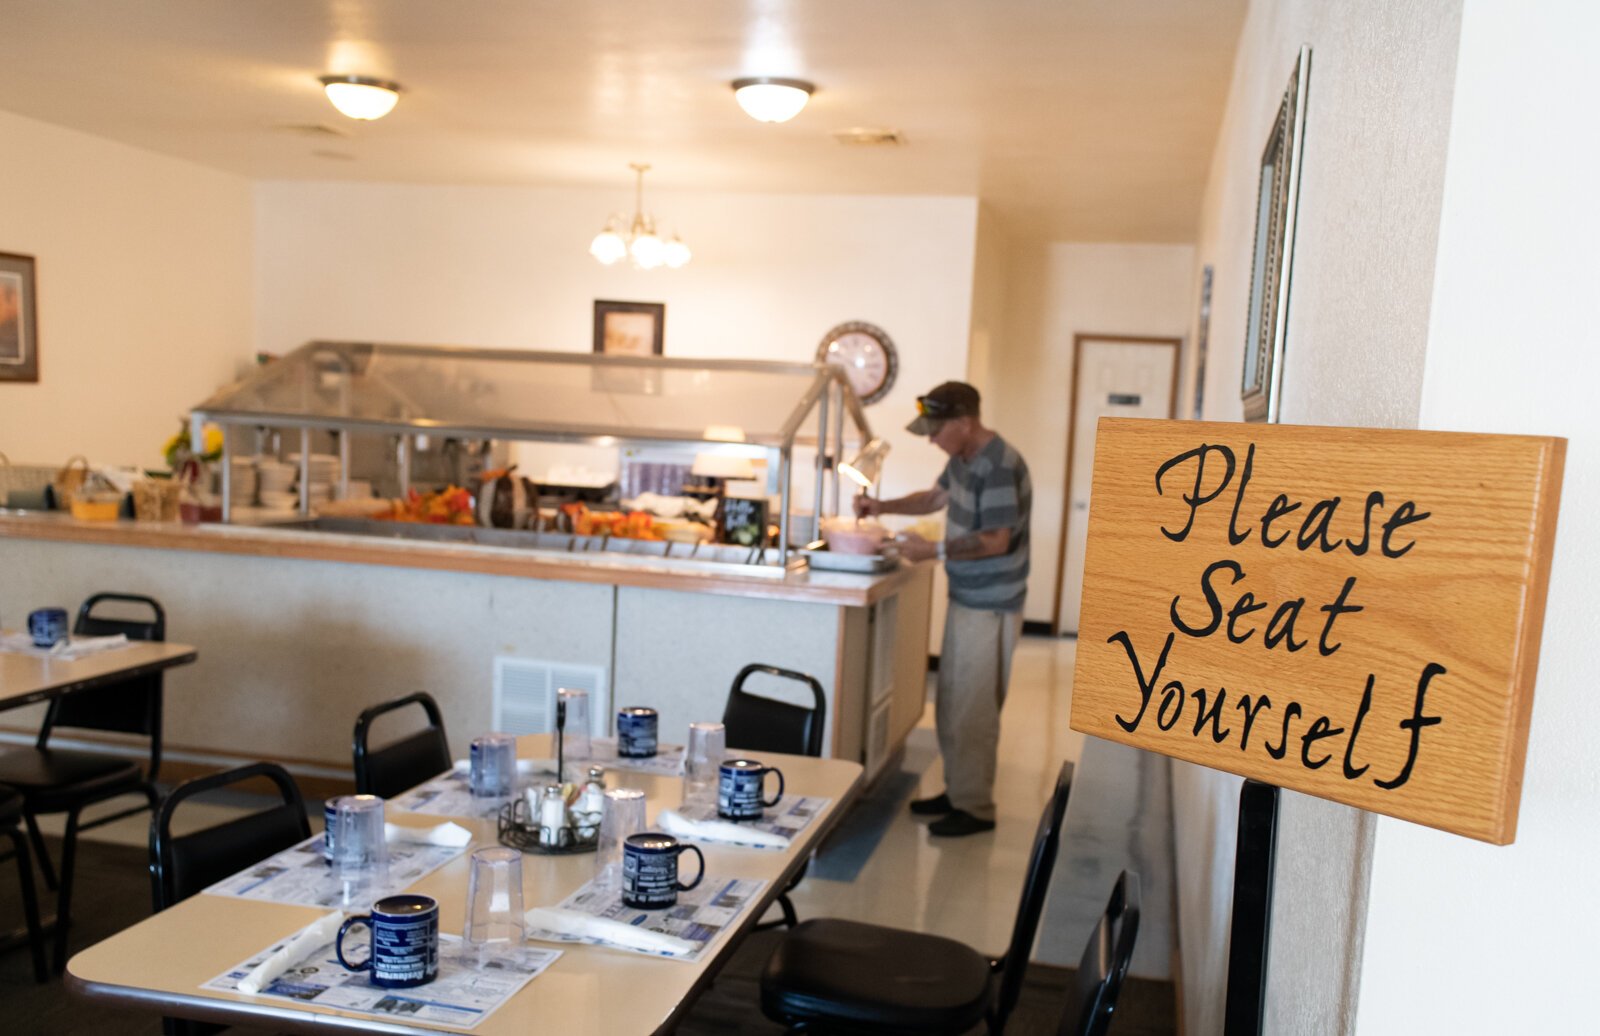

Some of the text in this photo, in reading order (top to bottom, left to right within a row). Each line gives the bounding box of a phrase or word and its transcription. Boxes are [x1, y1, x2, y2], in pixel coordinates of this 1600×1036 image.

[1155, 442, 1431, 559] Please
[1169, 559, 1364, 657] Seat
[1106, 630, 1447, 791] Yourself
